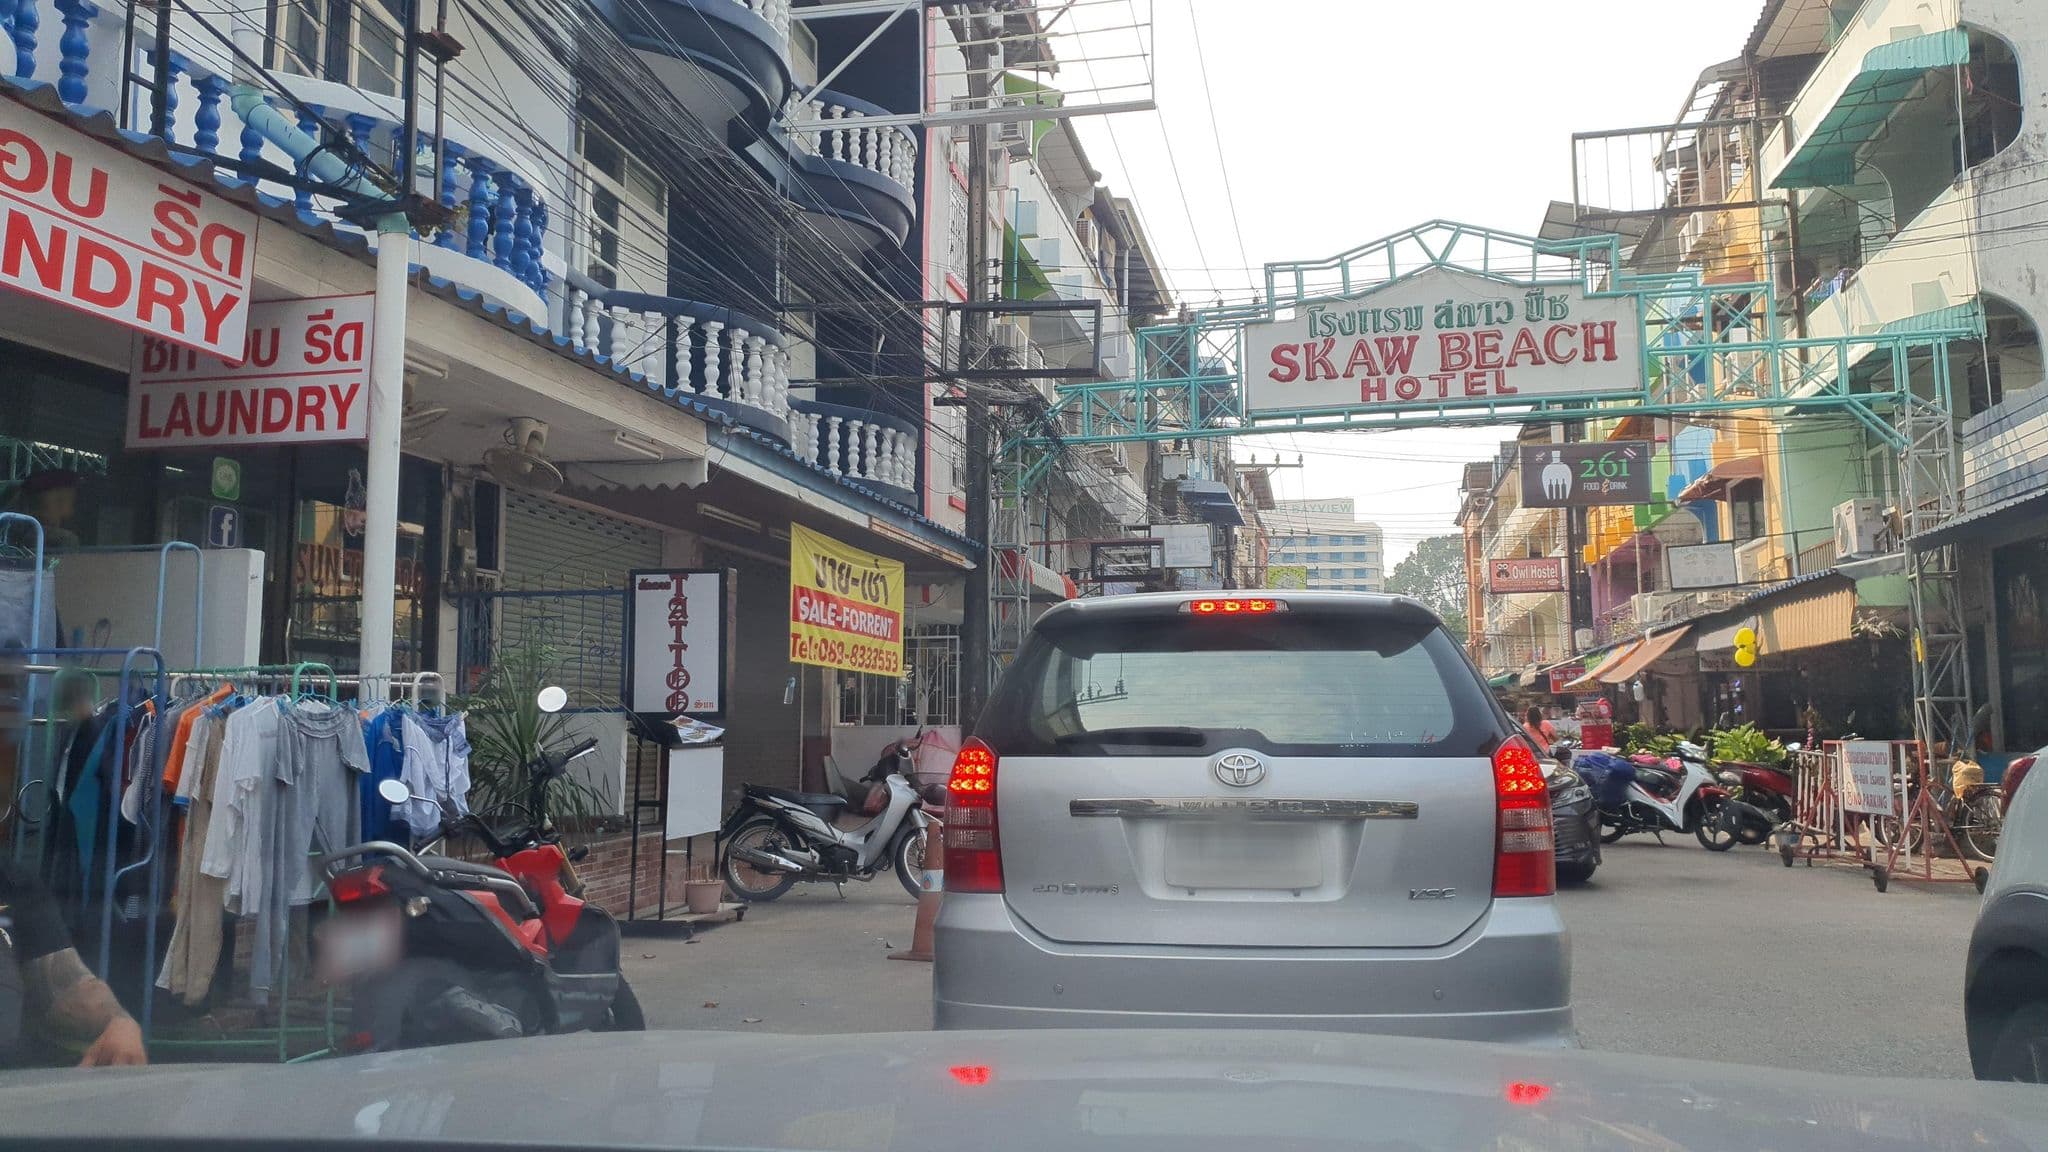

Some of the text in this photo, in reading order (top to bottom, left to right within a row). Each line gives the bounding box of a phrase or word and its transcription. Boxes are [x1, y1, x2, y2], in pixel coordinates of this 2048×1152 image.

[150, 183, 247, 280] รีด
[1306, 302, 1424, 339] โรงแรม
[1523, 287, 1570, 323] บีช
[303, 308, 364, 365] รีด
[1269, 320, 1618, 382] SKAW BEACH
[1361, 369, 1518, 402] HOTEL
[138, 382, 361, 440] LAUNDRY
[1580, 450, 1631, 478] 261
[1583, 482, 1600, 491] FOOD
[1512, 563, 1558, 580] Owl Hostel
[800, 597, 893, 638] SALE-FORRENT
[1863, 793, 1888, 809] PARKING
